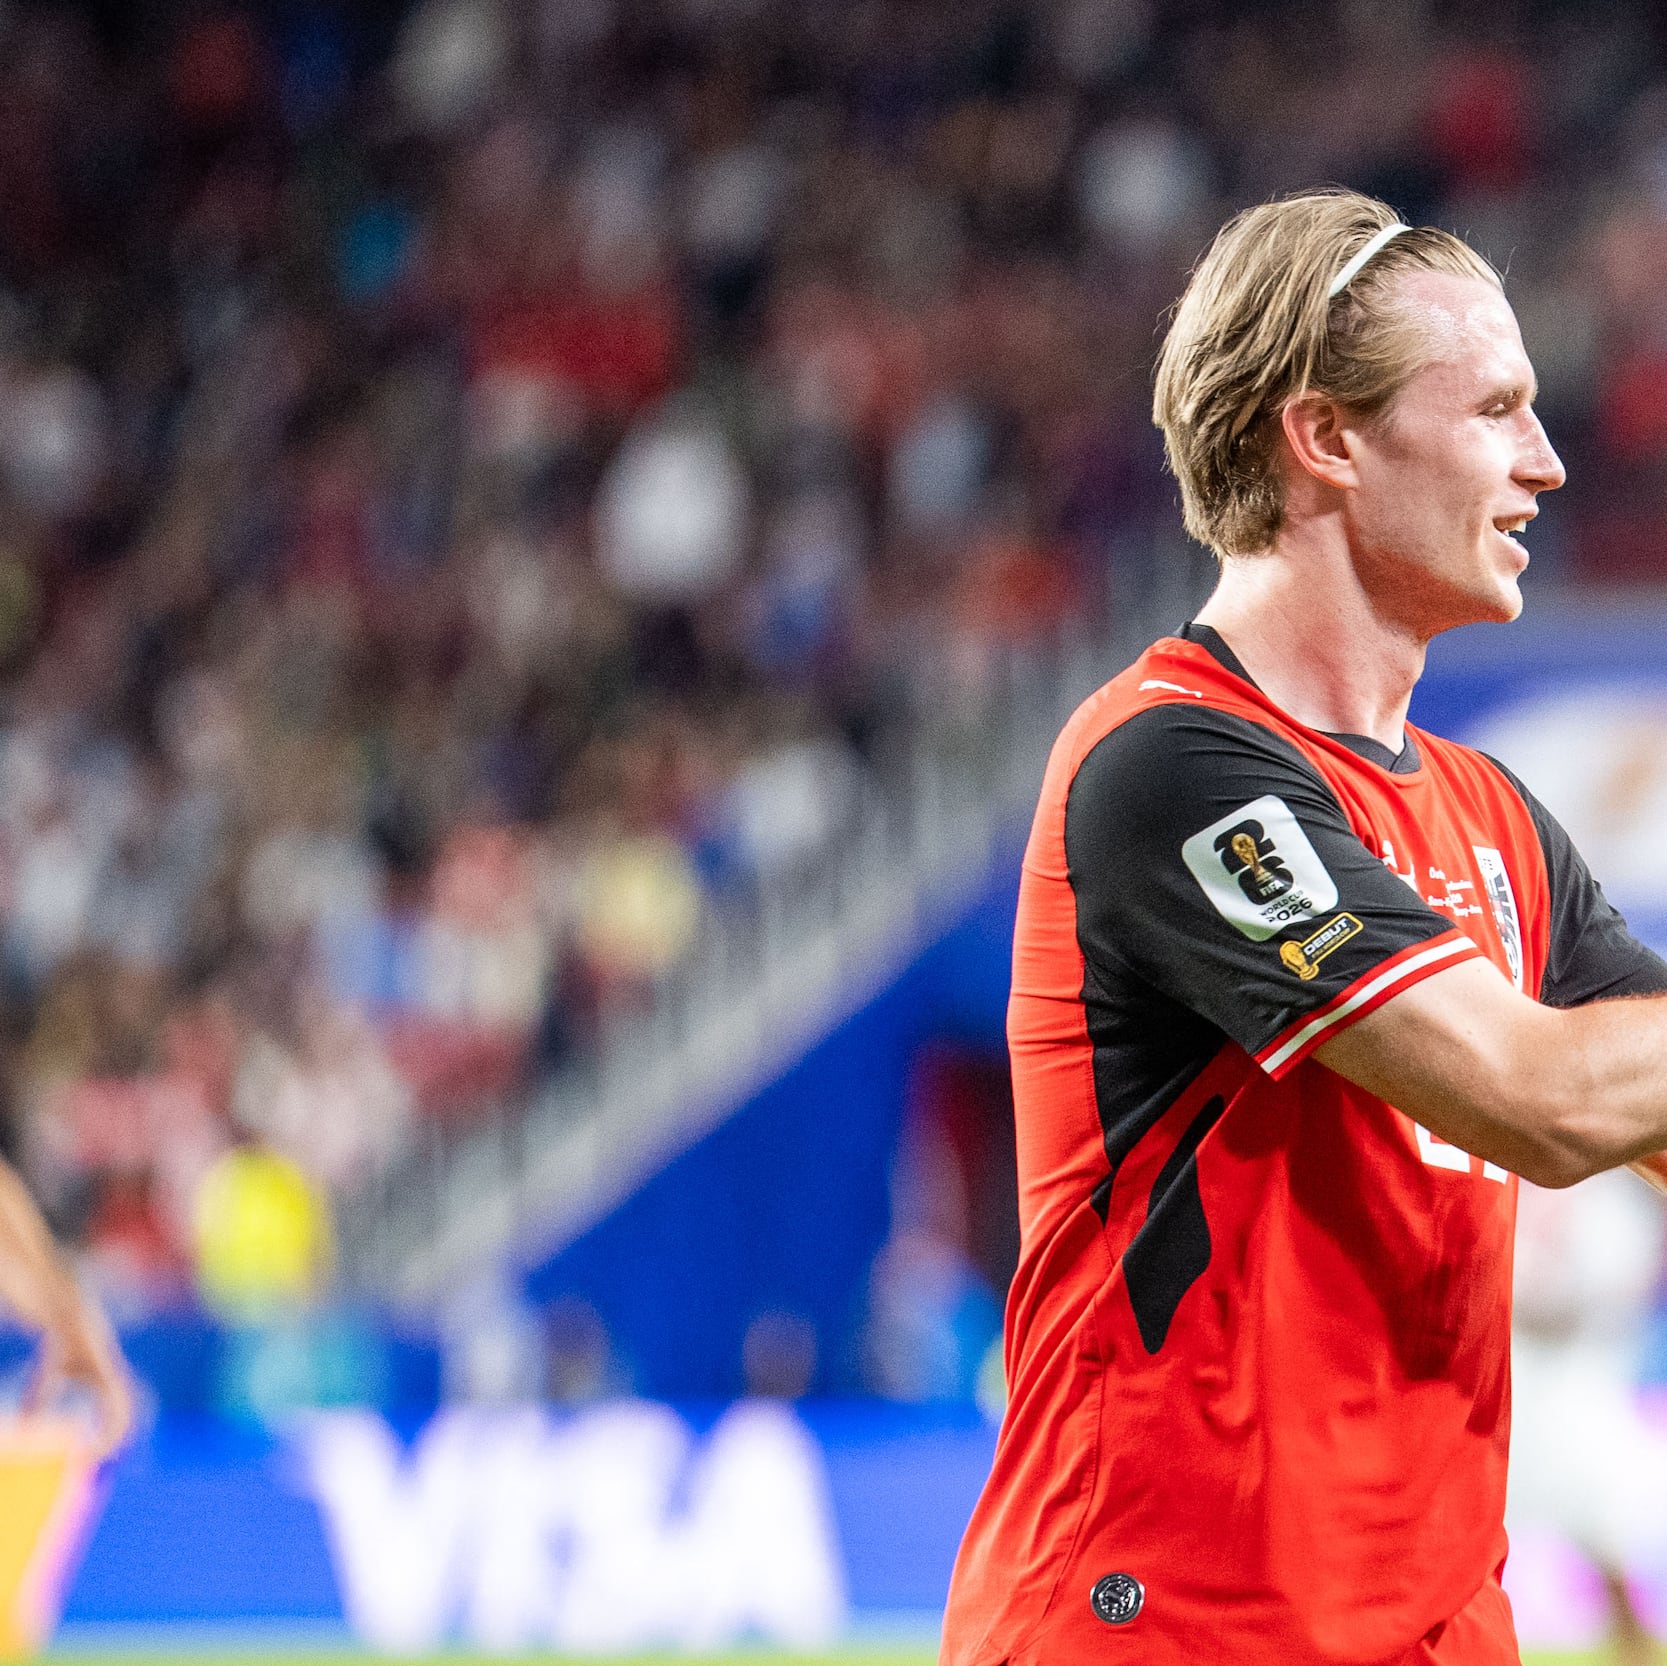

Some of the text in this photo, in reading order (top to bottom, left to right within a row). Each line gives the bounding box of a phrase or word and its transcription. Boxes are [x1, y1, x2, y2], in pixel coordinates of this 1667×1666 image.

[1259, 879, 1285, 898] FIFA
[1259, 895, 1291, 917] WORLD
[1303, 917, 1348, 956] DEBUT
[302, 1402, 850, 1652] VISA
